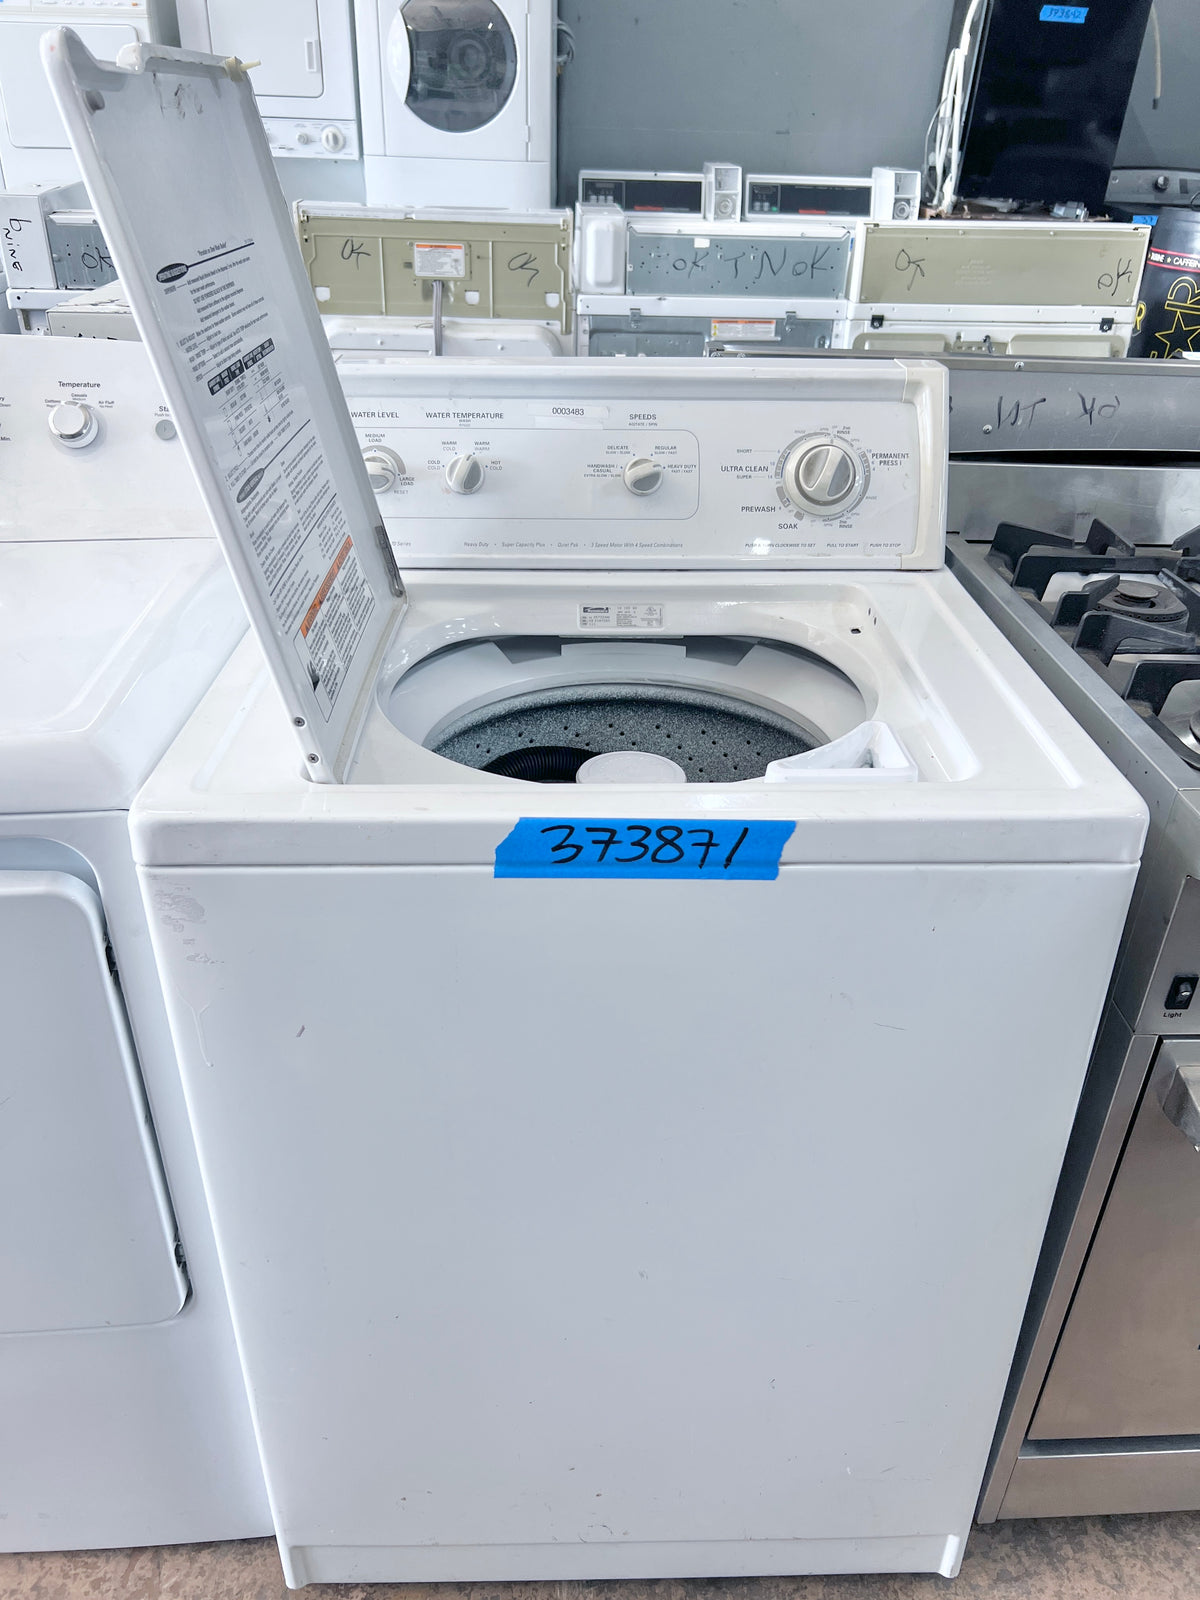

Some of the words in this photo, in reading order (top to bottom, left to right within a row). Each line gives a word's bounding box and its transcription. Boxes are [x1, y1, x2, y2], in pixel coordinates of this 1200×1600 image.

[58, 381, 101, 389] Temperature
[552, 407, 585, 416] 0003483
[540, 824, 749, 869] 373871
